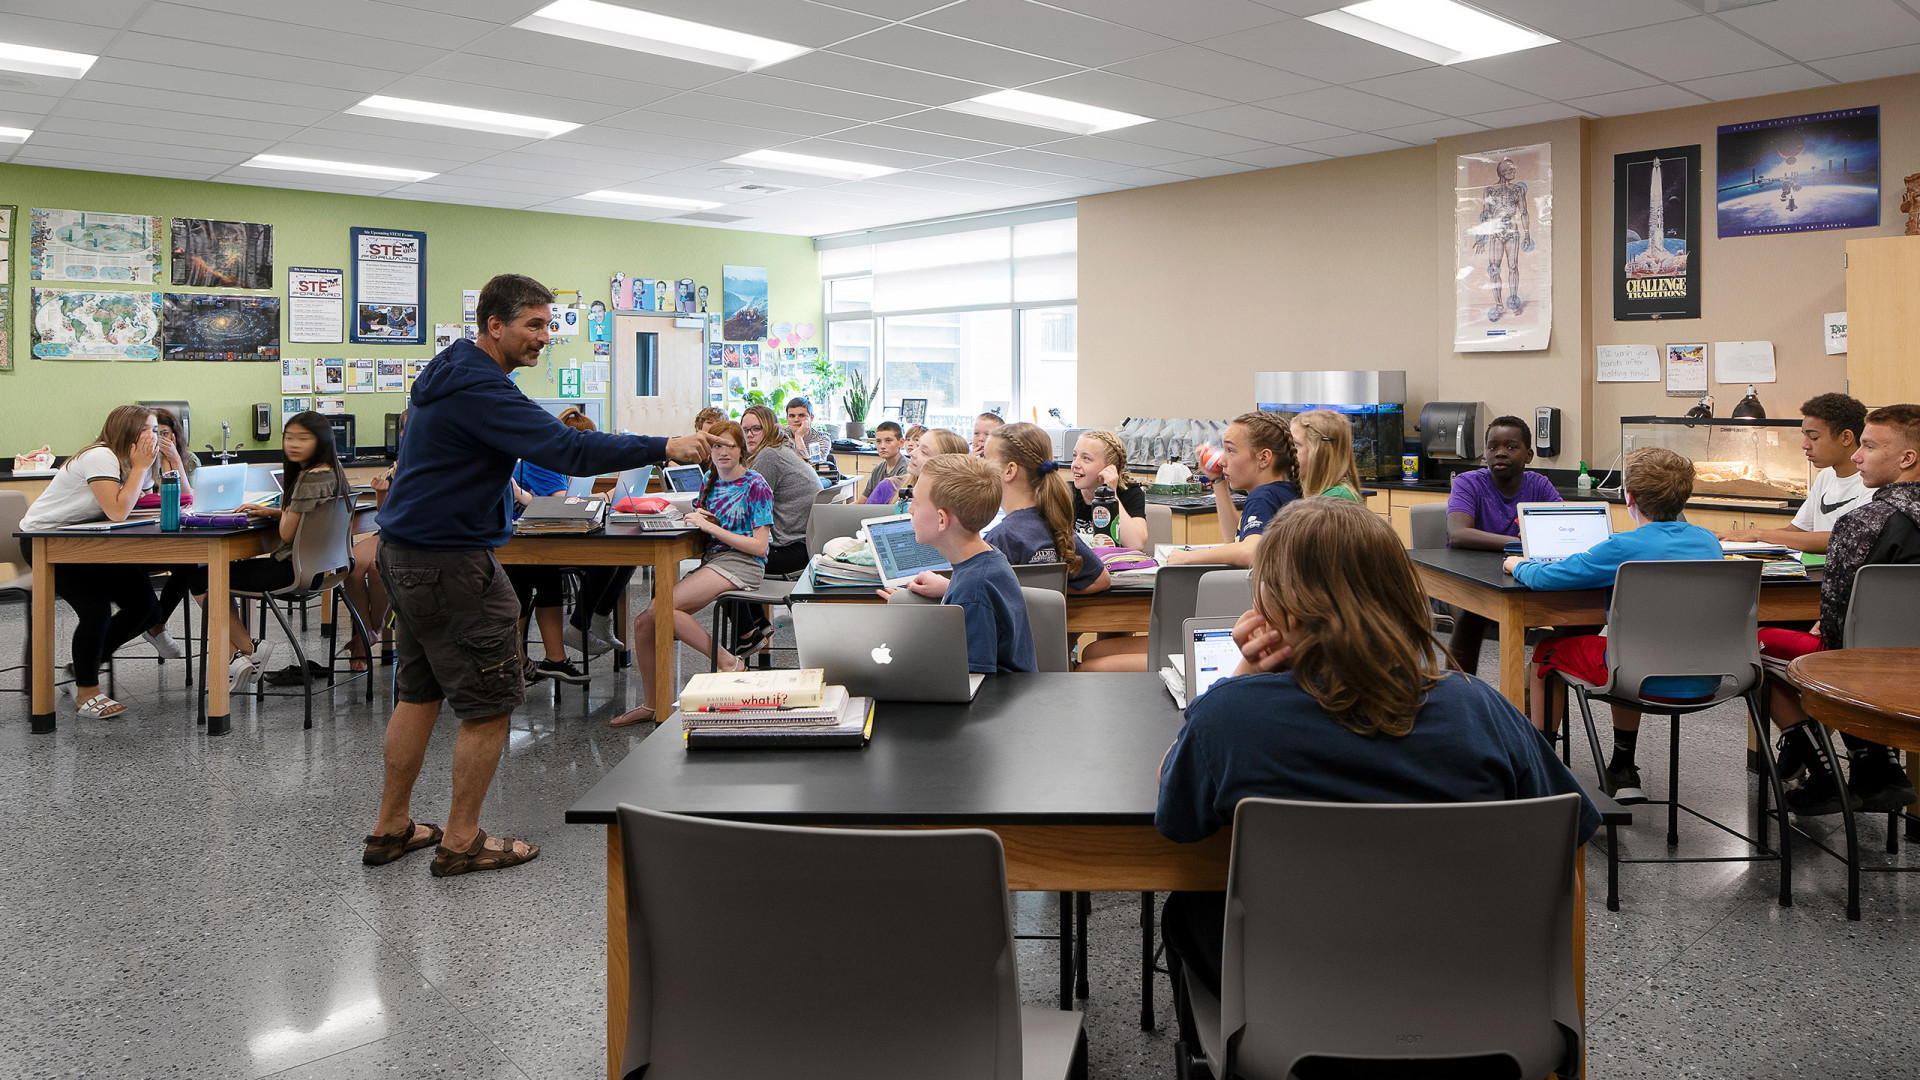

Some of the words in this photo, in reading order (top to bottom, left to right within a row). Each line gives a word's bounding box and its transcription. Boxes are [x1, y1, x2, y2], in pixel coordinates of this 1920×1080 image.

[1733, 123, 1760, 131] SPACE
[1768, 117, 1808, 126] STATION
[1816, 110, 1861, 120] FREEDOM
[361, 254, 417, 262] FORWARD
[1626, 277, 1687, 293] CHALLENGE
[1627, 290, 1687, 299] TRADITIONS
[1600, 346, 1611, 358] Plz
[1614, 350, 1632, 358] wash
[1635, 351, 1649, 359] your
[1600, 359, 1622, 368] hands
[1626, 358, 1643, 366] after
[1601, 369, 1627, 380] holding
[741, 693, 771, 705] what
[773, 692, 788, 705] if?
